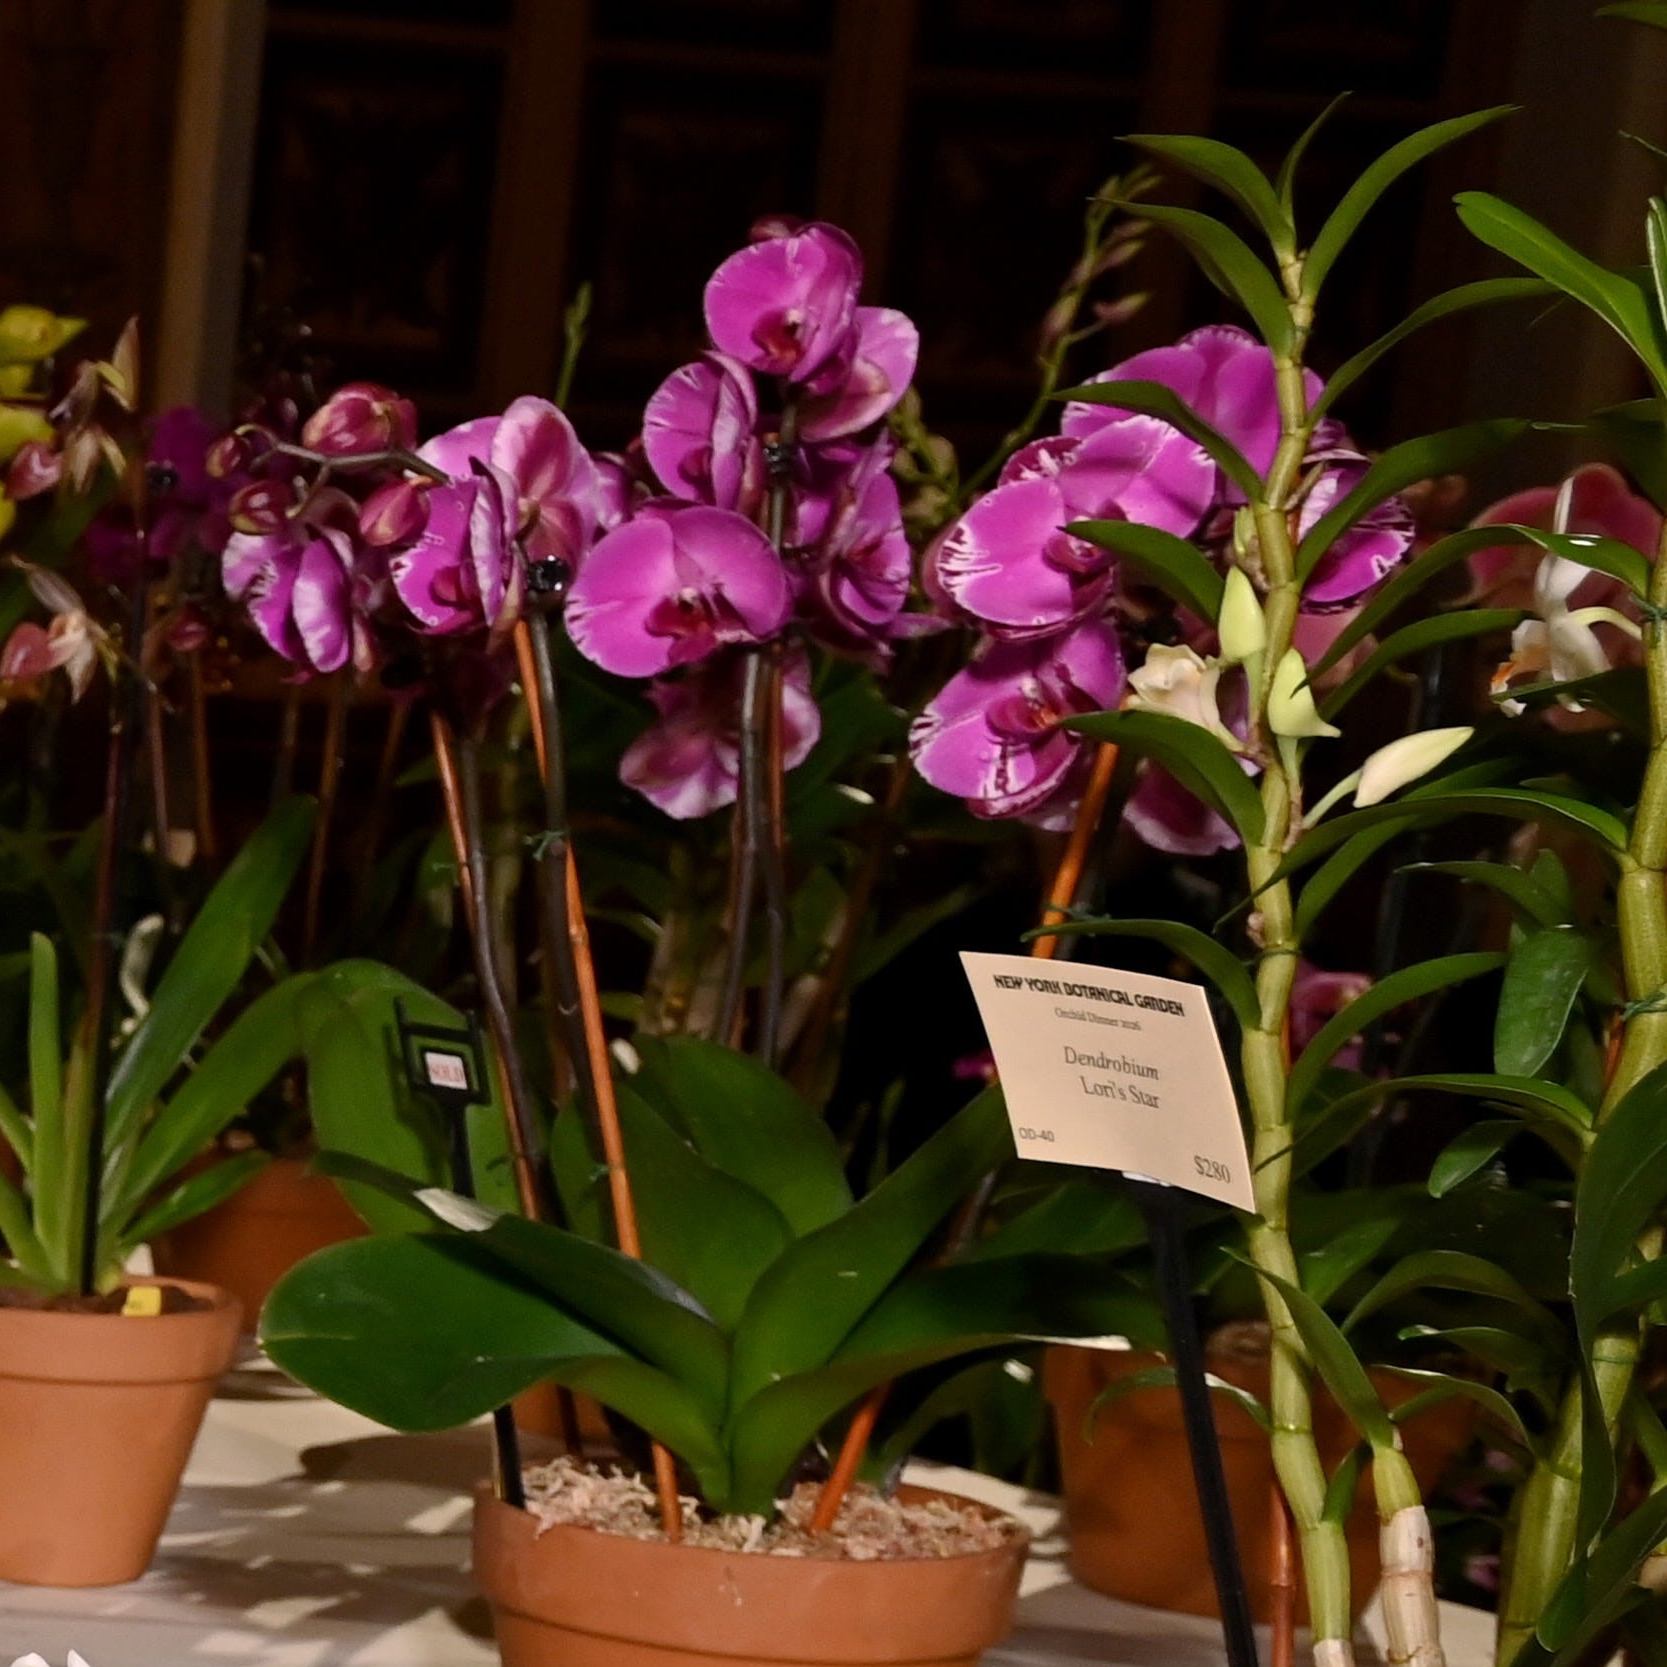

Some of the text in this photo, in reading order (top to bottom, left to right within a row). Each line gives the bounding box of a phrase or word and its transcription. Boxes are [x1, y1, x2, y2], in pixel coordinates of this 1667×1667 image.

[992, 974, 1186, 1017] NEW YORK BOTANICAL GARDEN
[1063, 1045, 1159, 1081] Dendrobium
[1079, 1075, 1160, 1108] Lori's Star
[1018, 1126, 1055, 1143] OD-40
[1193, 1155, 1231, 1184] $280
